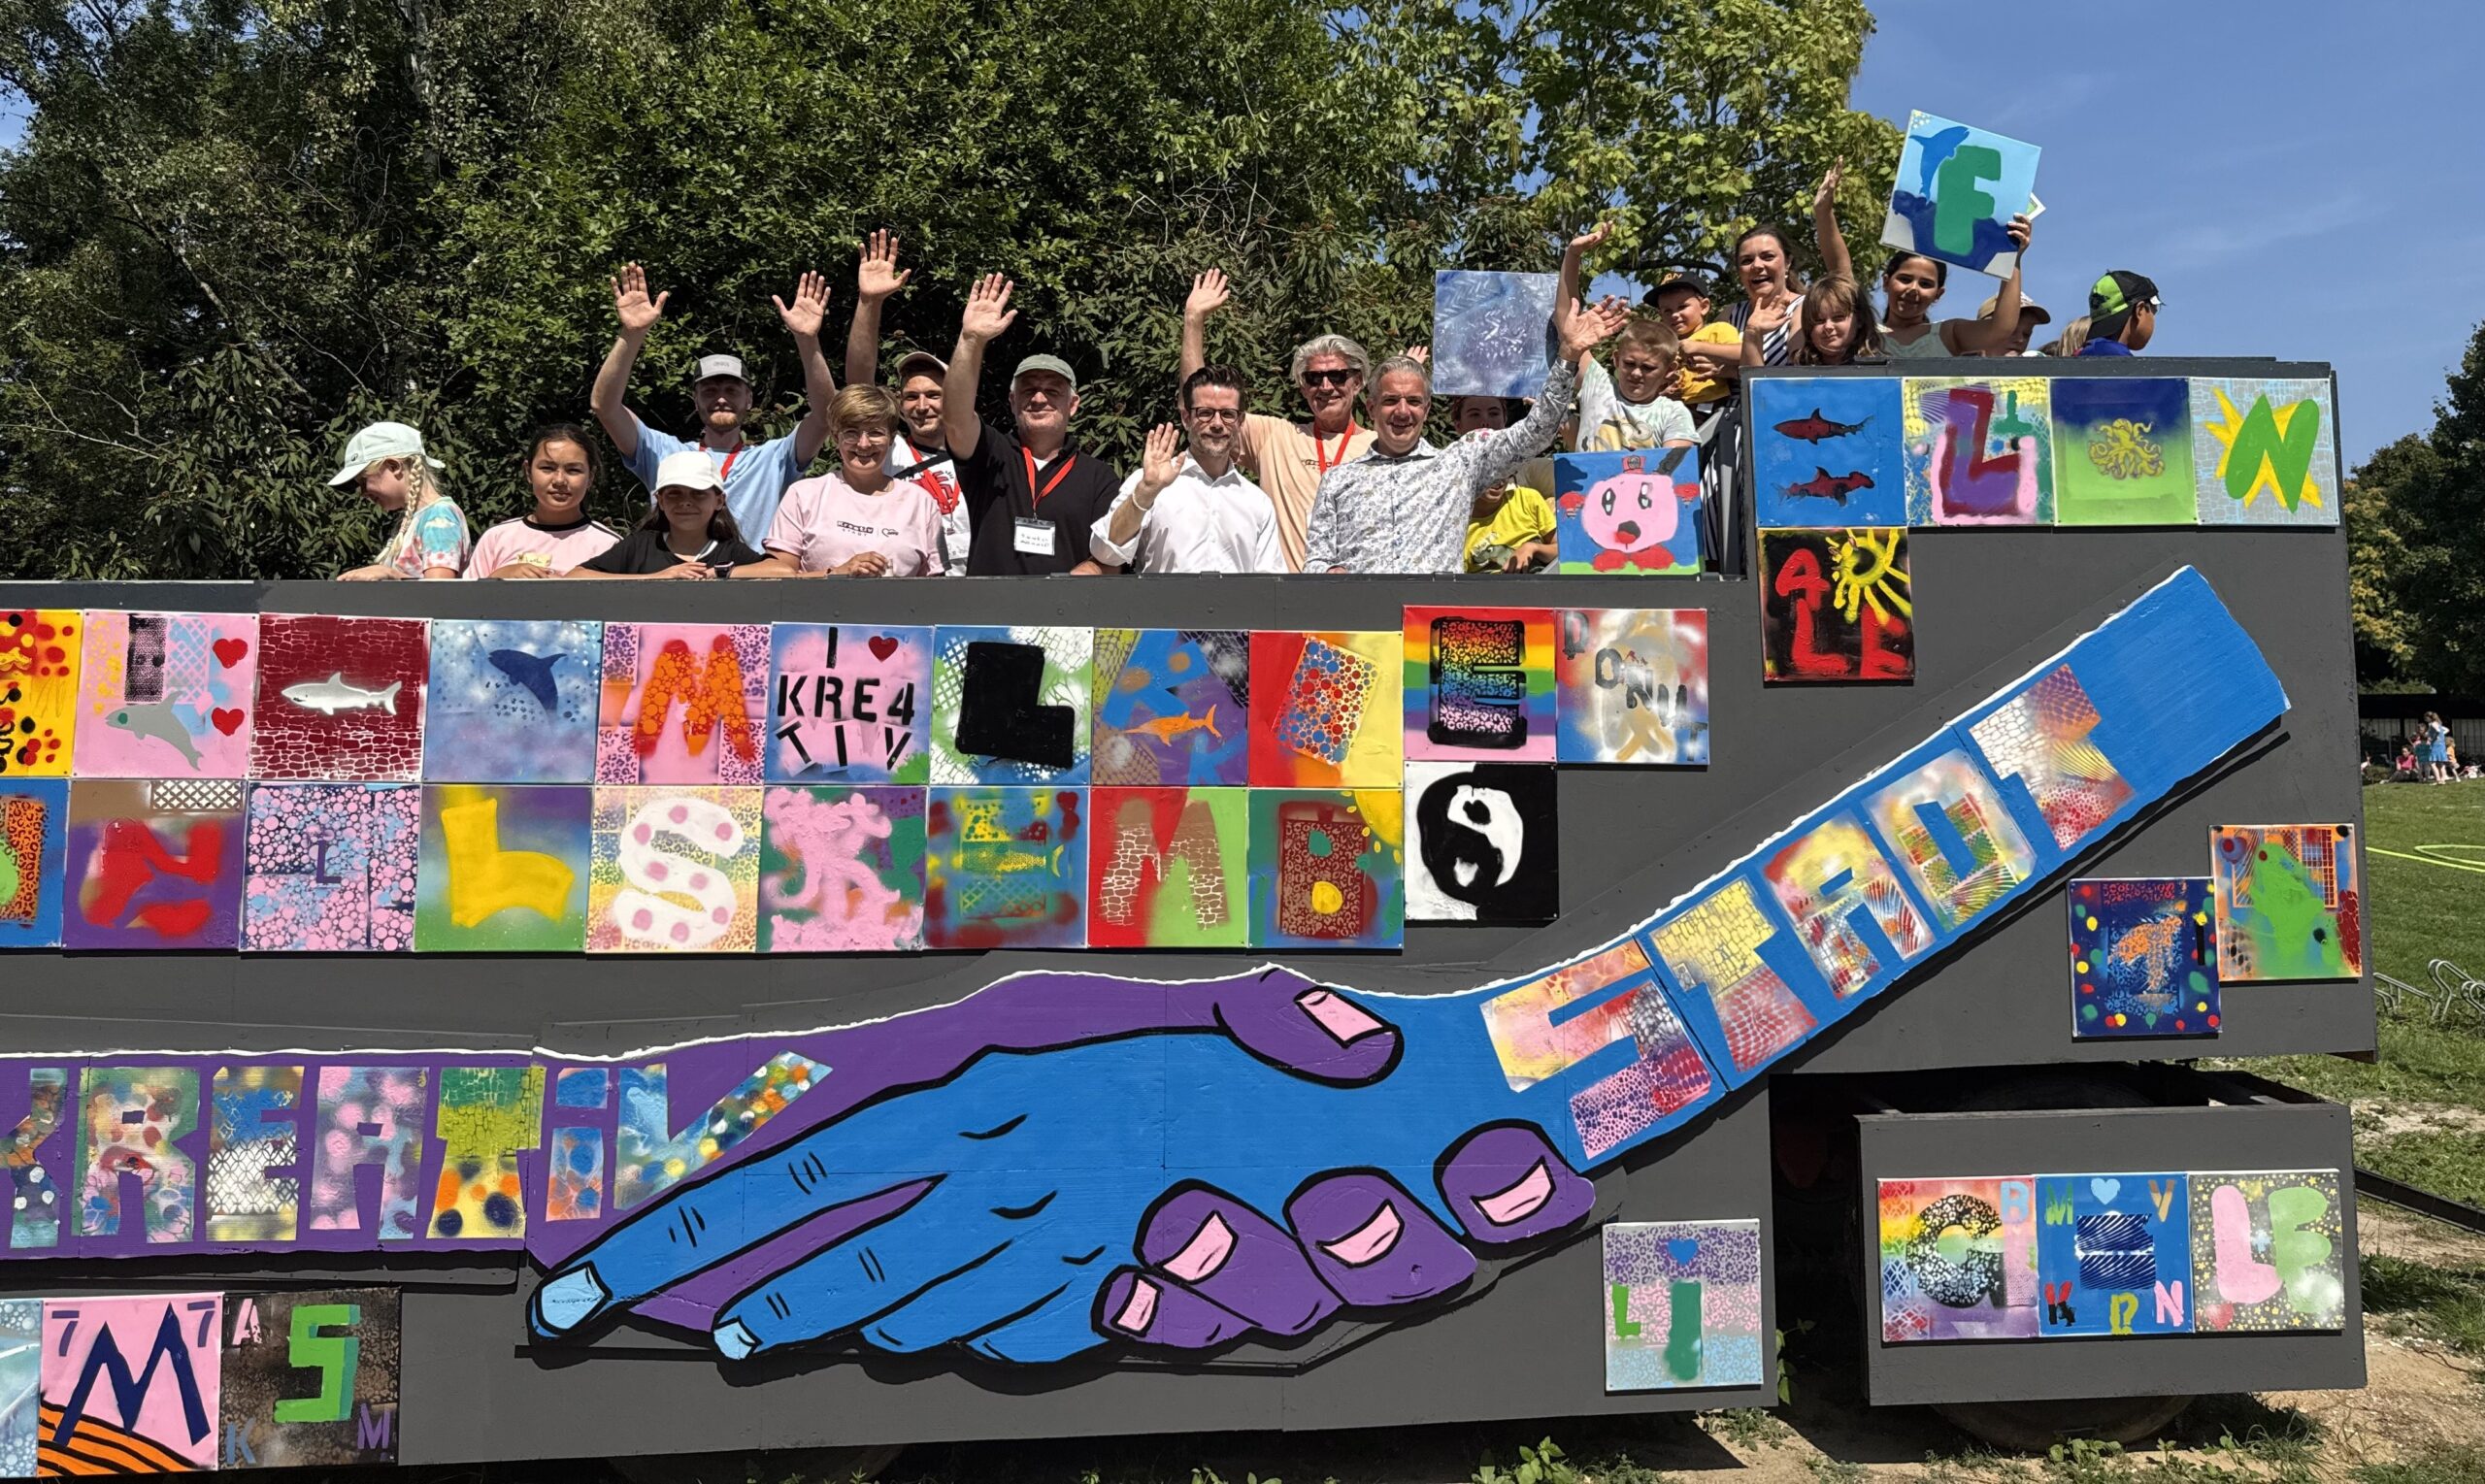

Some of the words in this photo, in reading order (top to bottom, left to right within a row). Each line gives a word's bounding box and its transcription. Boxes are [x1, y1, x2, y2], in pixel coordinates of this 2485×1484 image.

[1934, 145, 2001, 256] F
[2226, 394, 2320, 513] N
[633, 634, 755, 760] M
[826, 626, 838, 669] I
[954, 642, 1075, 770] L
[1427, 616, 1528, 749] E
[613, 797, 745, 944] S
[1096, 798, 1230, 931] M
[1480, 664, 2134, 1160] STADT
[51, 1310, 80, 1357] 7
[52, 1303, 211, 1447] M
[187, 1301, 215, 1348] 7
[273, 1303, 361, 1424] S
